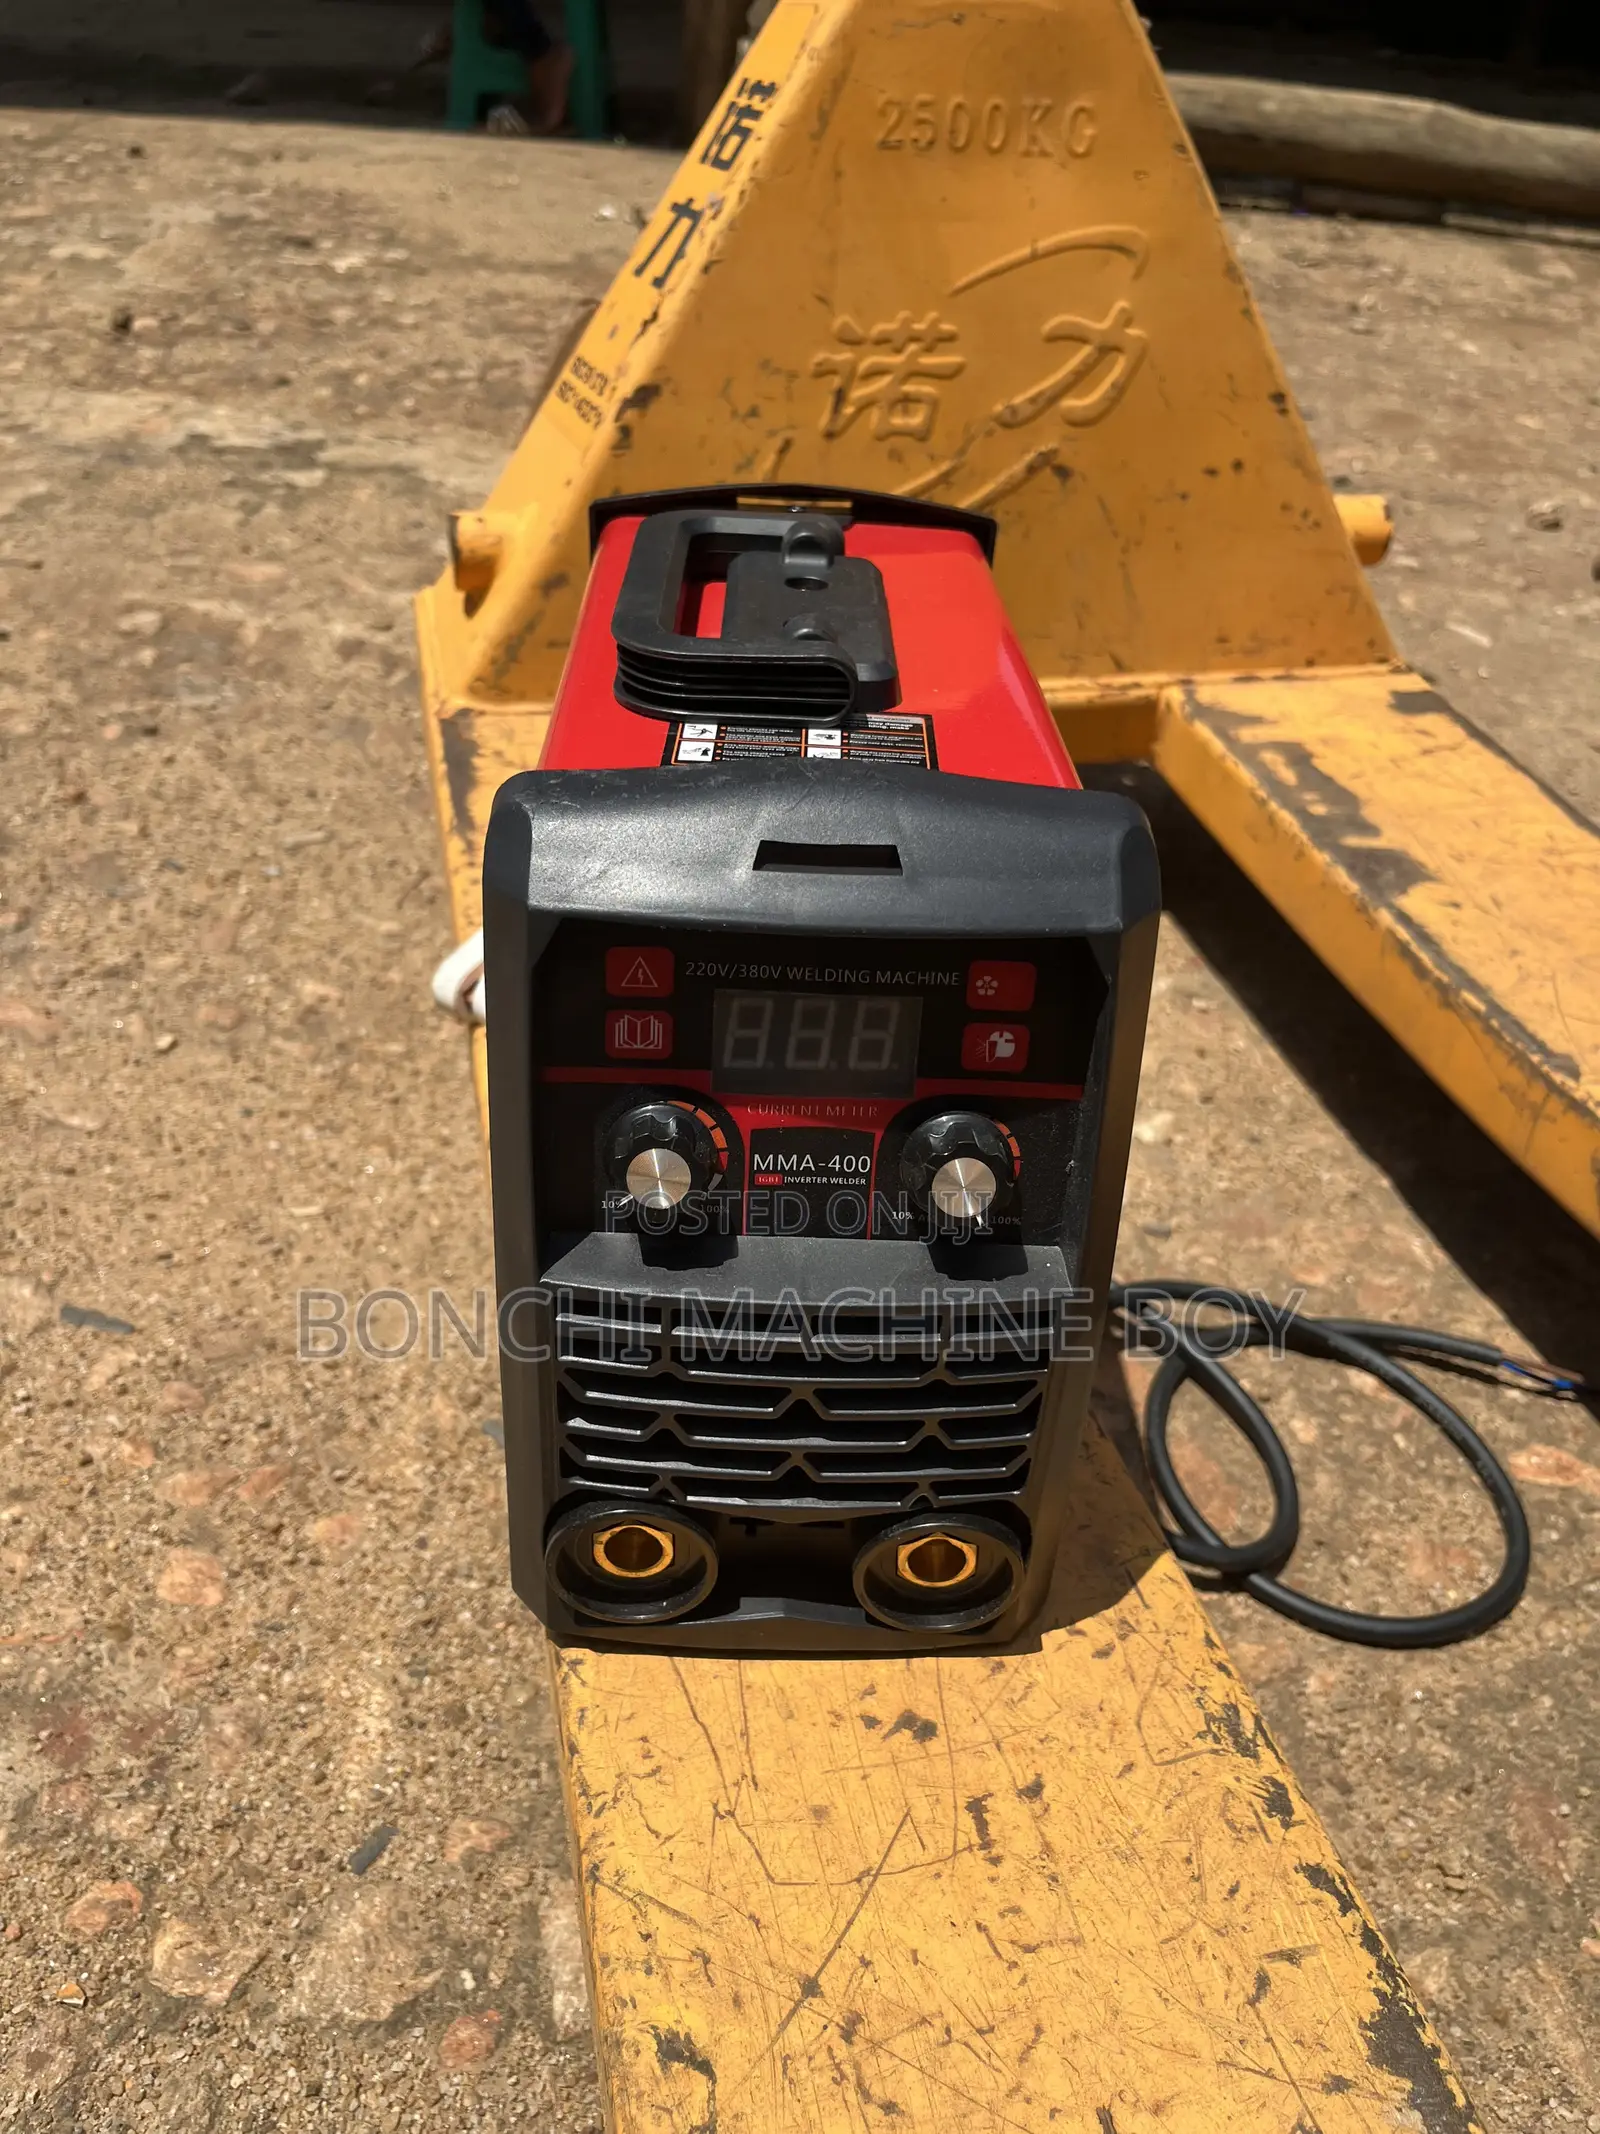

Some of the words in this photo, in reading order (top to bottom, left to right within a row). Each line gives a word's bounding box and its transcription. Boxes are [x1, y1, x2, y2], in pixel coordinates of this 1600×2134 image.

[876, 97, 1098, 158] 2500KG
[811, 301, 1149, 442] 诺力
[686, 961, 782, 979] 220V/380V
[787, 966, 870, 984] WELDING
[876, 970, 960, 986] MACHINE
[747, 1102, 820, 1117] CURRENT
[826, 1104, 879, 1118] METER
[753, 1154, 871, 1173] MMA-400
[784, 1176, 828, 1184] INVERTER
[829, 1177, 867, 1186] WELDER
[892, 1211, 914, 1220] 10%
[991, 1216, 1022, 1225] 100%
